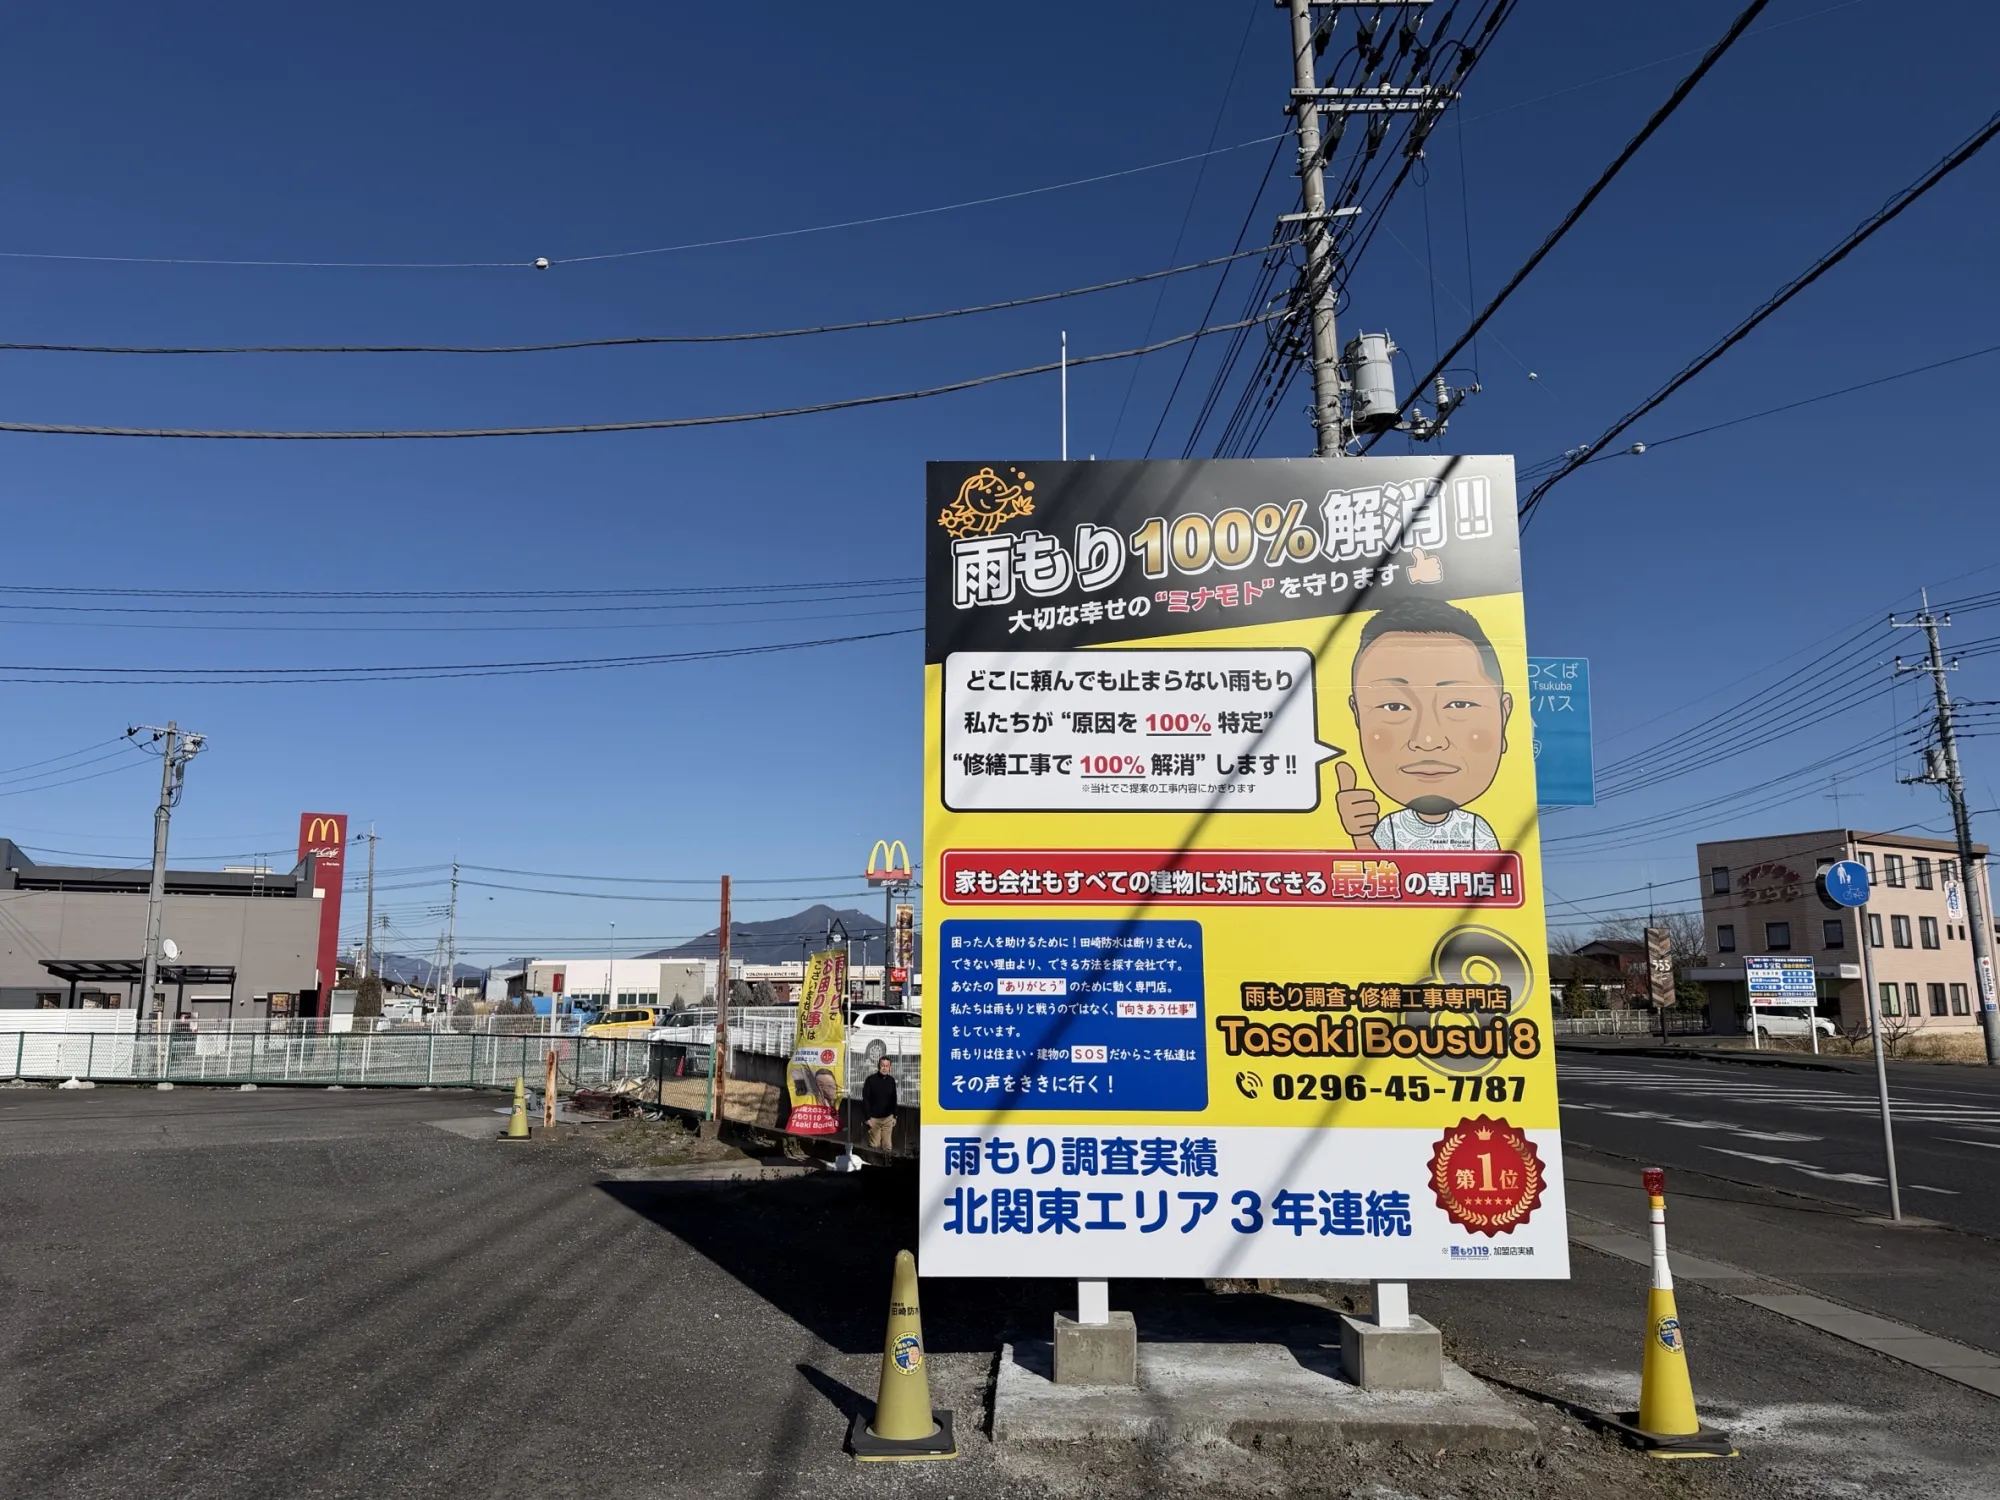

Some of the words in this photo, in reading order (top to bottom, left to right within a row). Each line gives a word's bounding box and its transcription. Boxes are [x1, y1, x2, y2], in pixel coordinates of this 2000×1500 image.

[966, 669, 1293, 692] どこに頼んでも止まらない雨もり
[1532, 681, 1572, 691] Tsukuba
[1244, 985, 1508, 1010] 雨もり調査・修繕工事専門店
[952, 1025, 1021, 1038] をしています。
[1219, 1017, 1355, 1055] Tasaki
[1364, 1019, 1505, 1056] Bousui
[1512, 1021, 1538, 1056] 8
[1272, 1073, 1527, 1102] 0296-45-7787
[943, 1136, 1219, 1178] 雨もり調査実績
